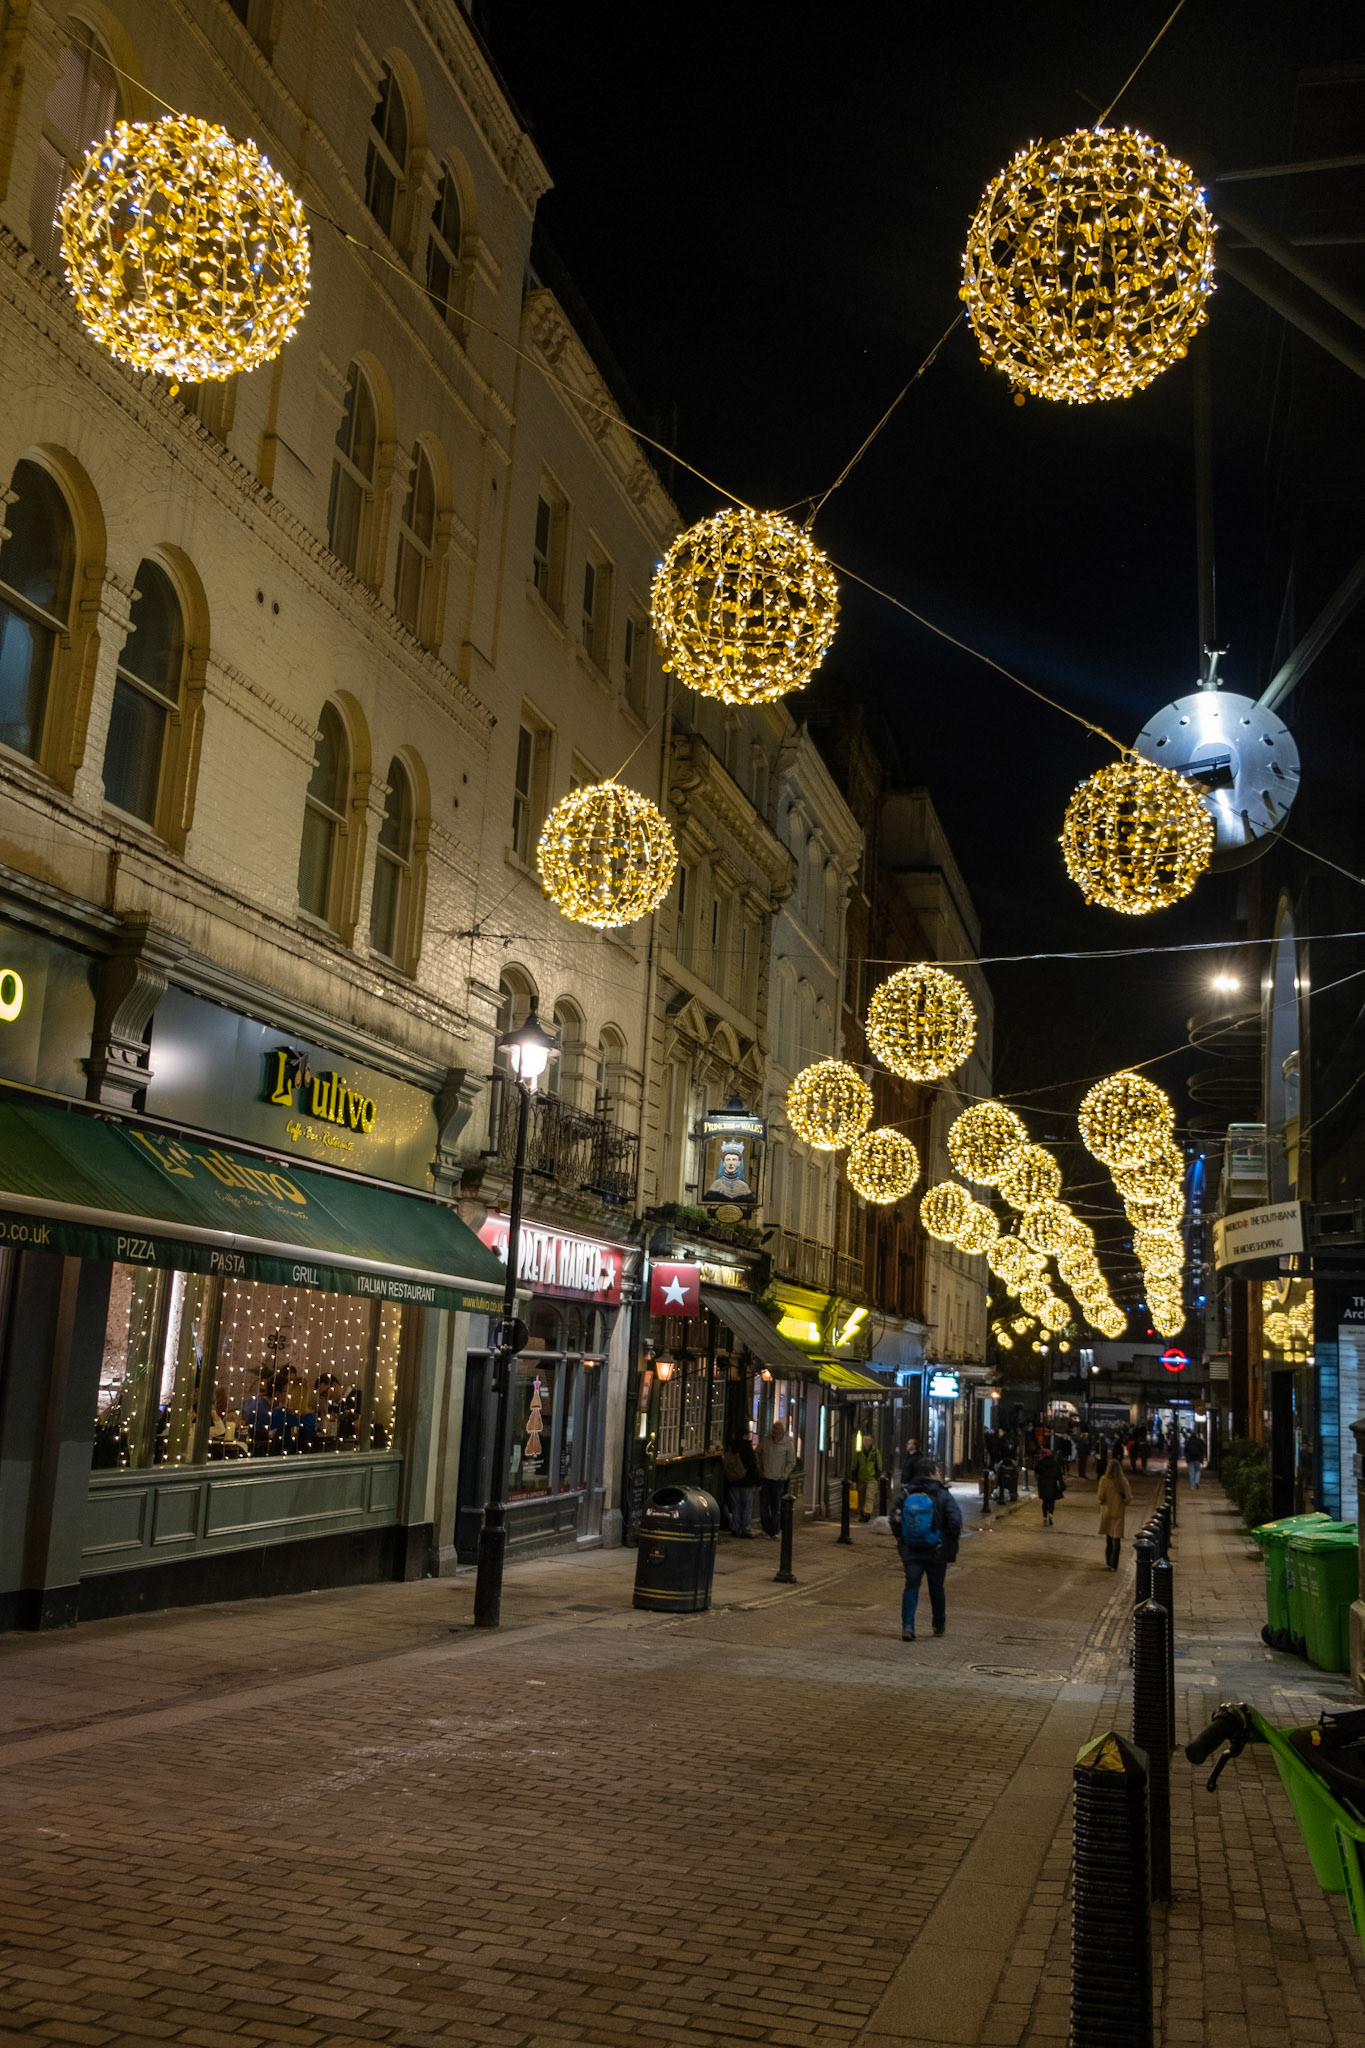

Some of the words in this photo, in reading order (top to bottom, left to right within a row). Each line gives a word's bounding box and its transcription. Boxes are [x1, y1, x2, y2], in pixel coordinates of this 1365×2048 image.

[117, 1236, 157, 1261] PIZZA
[210, 1250, 246, 1274] PASTA
[559, 1239, 602, 1293] MANGER
[292, 1264, 320, 1286] GRILL
[357, 1276, 388, 1296] ITALIAN
[388, 1281, 436, 1302] RESTAURANT
[1343, 1308, 1365, 1319] Arc
